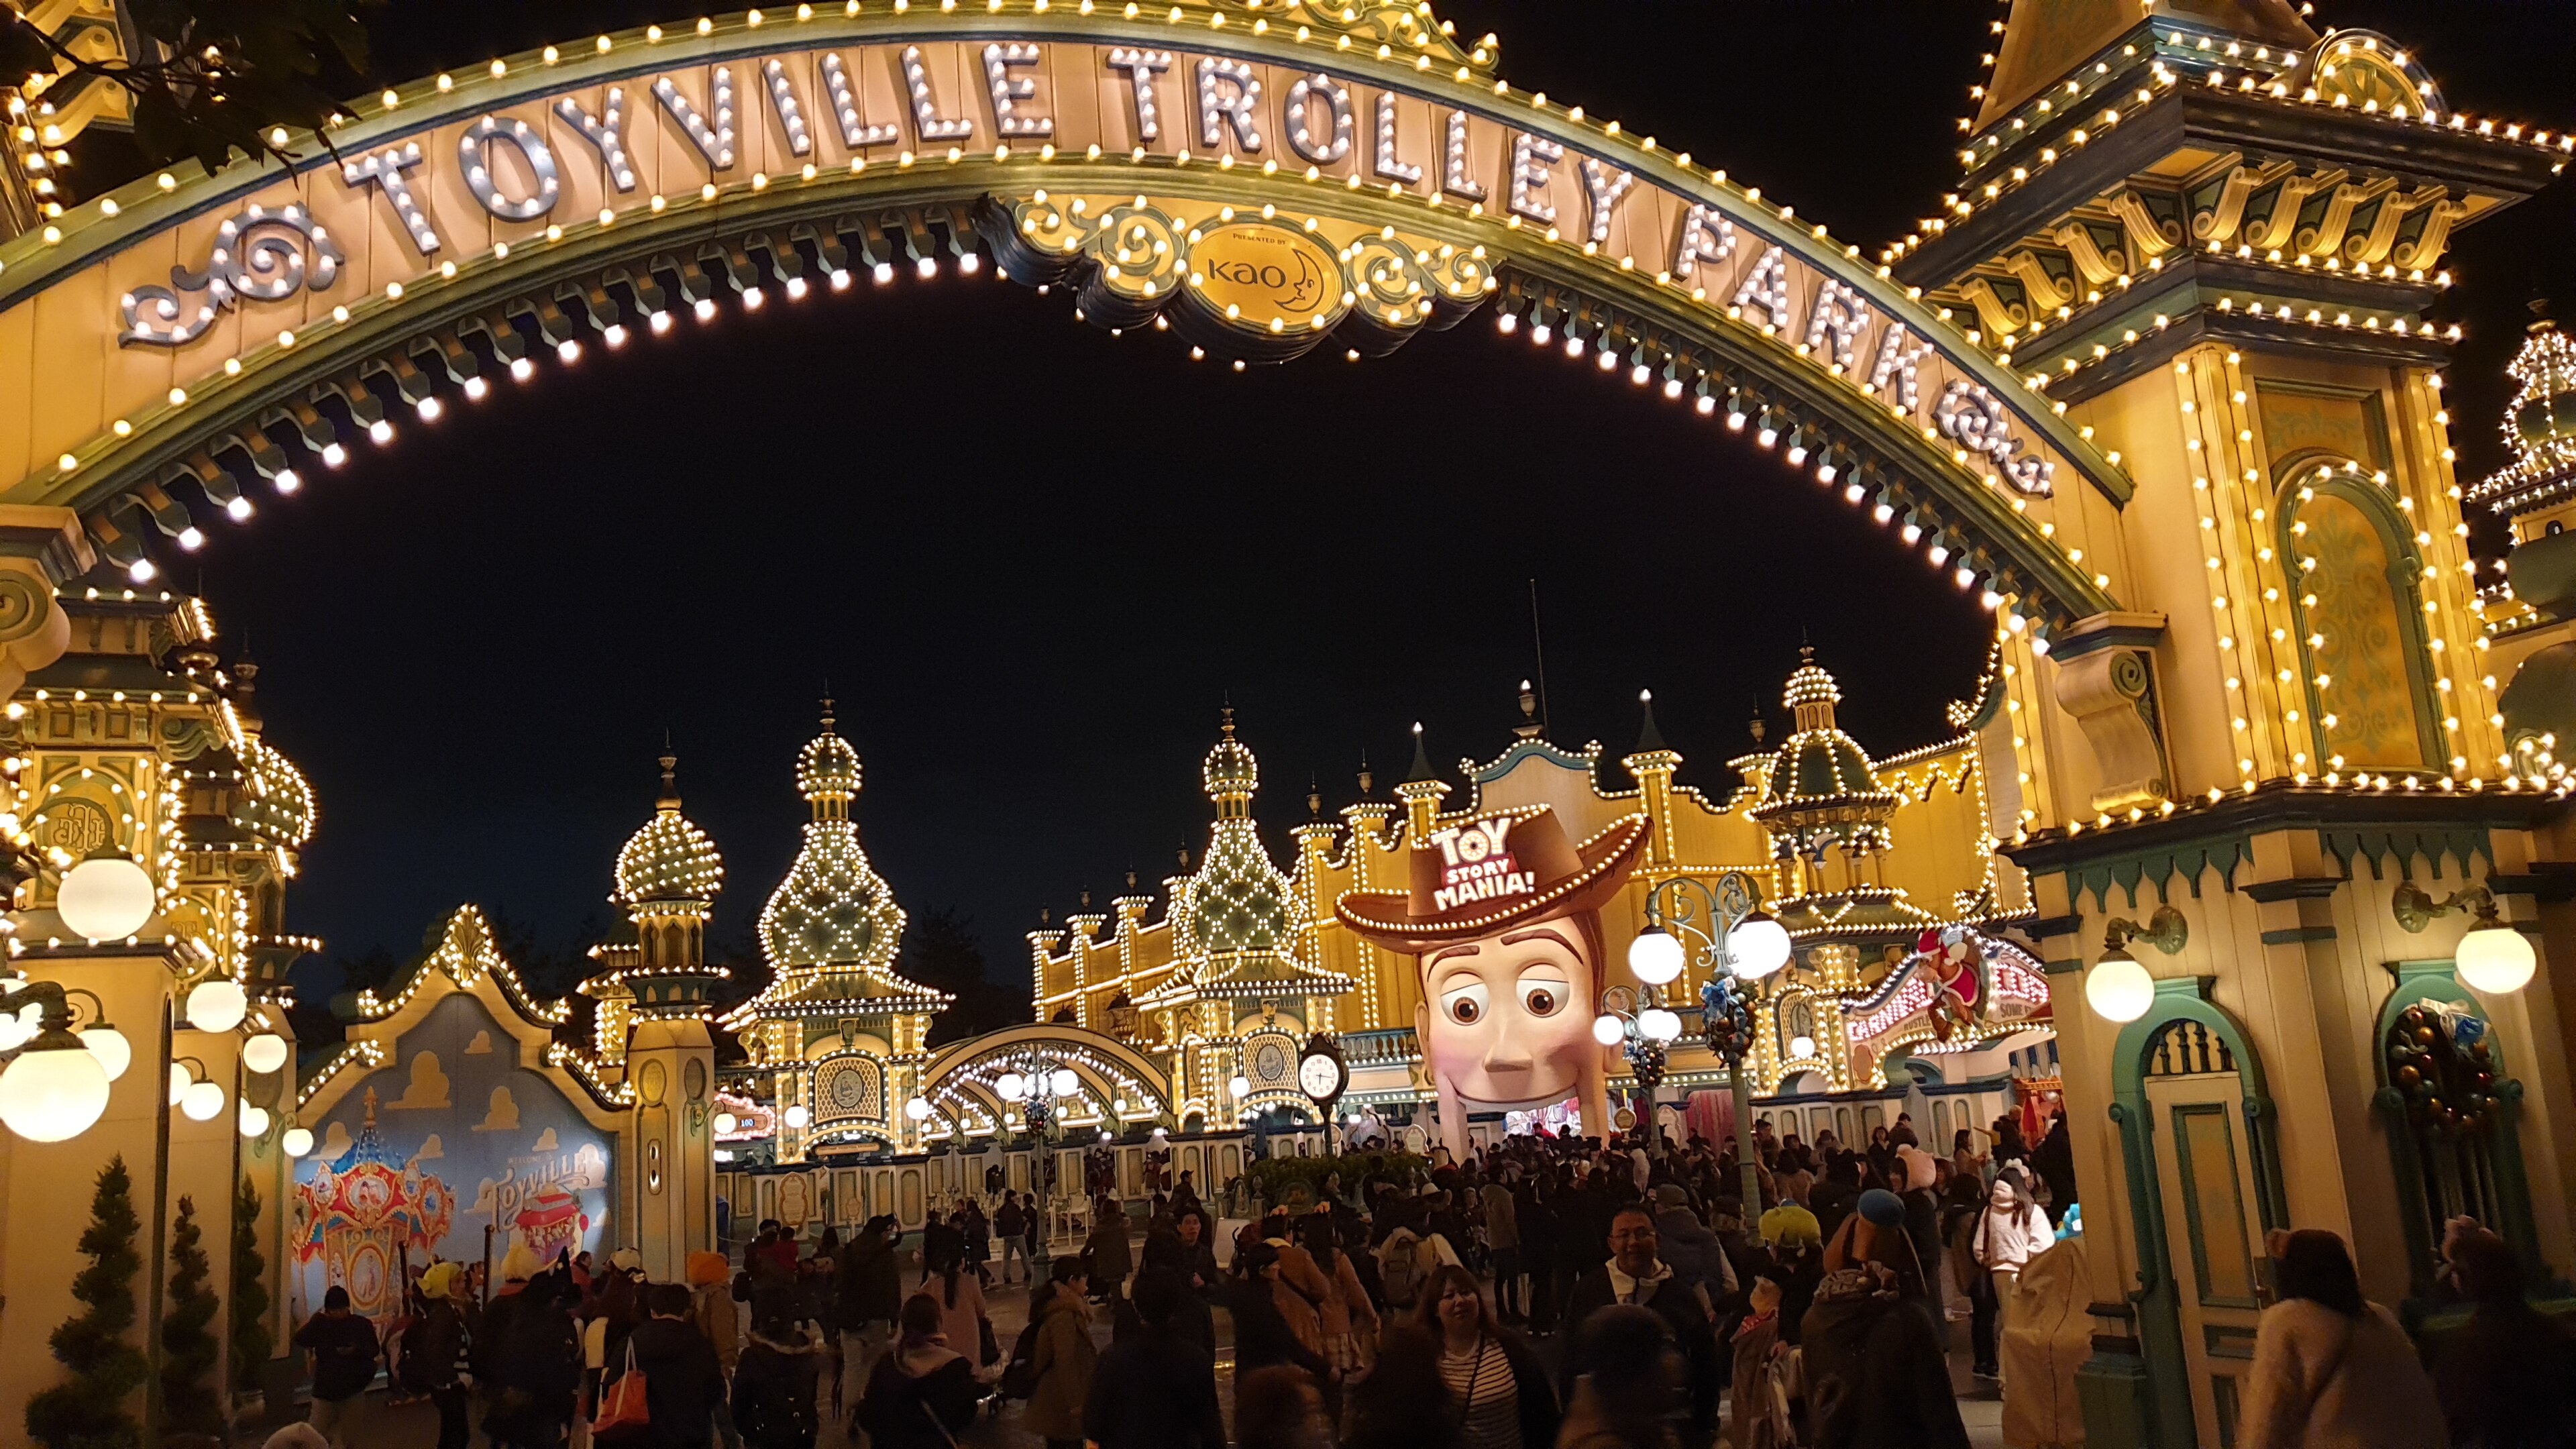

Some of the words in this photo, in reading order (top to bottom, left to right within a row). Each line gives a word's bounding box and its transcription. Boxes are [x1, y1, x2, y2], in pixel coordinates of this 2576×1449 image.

[342, 44, 1053, 255] TOYVILLE
[1106, 47, 1634, 244] TROLLEY
[1674, 202, 1936, 416] PARK
[1233, 233, 1275, 244] PRESENTED
[1431, 817, 1512, 866] TOY
[1446, 857, 1509, 885] STORY
[1434, 871, 1535, 911] MANIA!
[2000, 1002, 2023, 1018] SOME
[741, 1118, 754, 1127] 100
